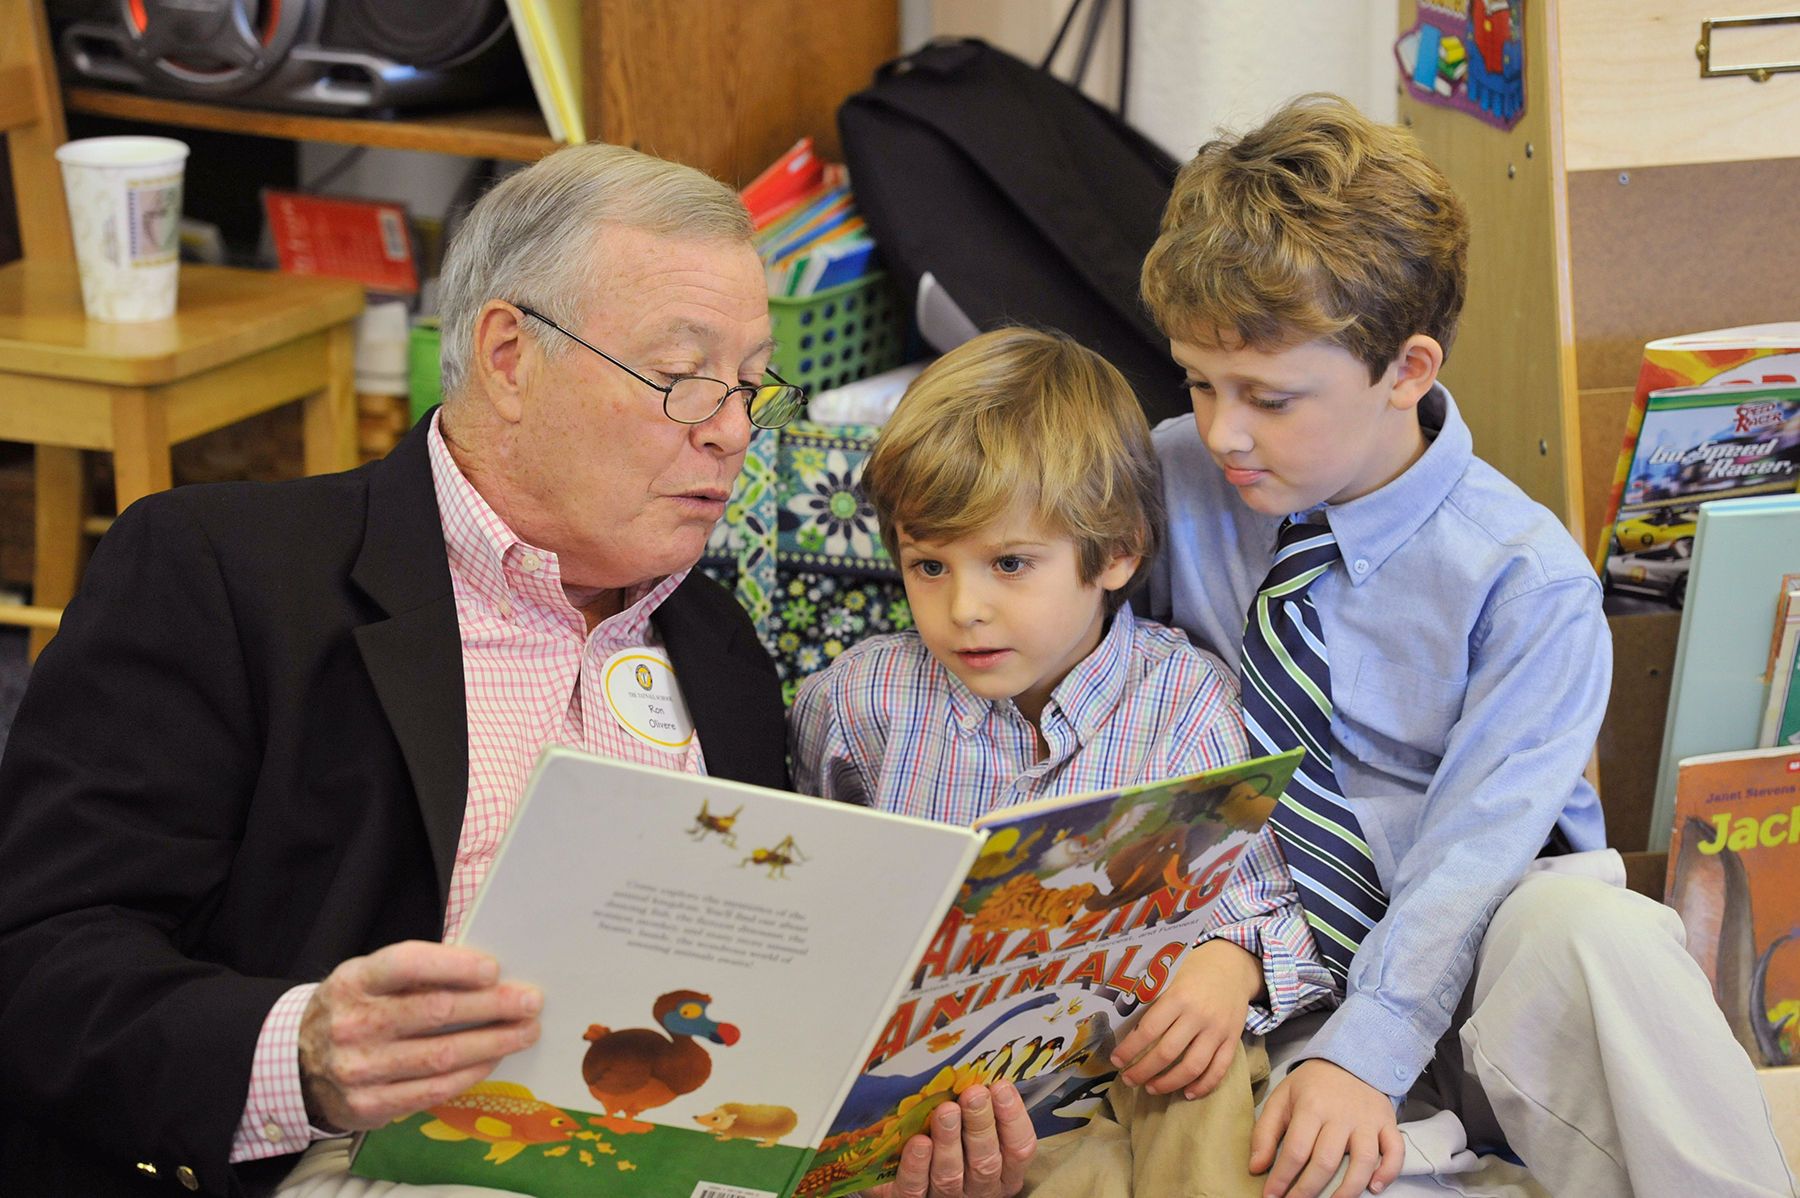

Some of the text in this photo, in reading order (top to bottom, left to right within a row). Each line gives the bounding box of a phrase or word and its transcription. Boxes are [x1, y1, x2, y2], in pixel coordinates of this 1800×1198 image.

[1699, 438, 1779, 465] Speed
[648, 704, 665, 715] Ron
[918, 842, 1245, 978] AMAZING
[861, 940, 1188, 1074] ANIMALS
